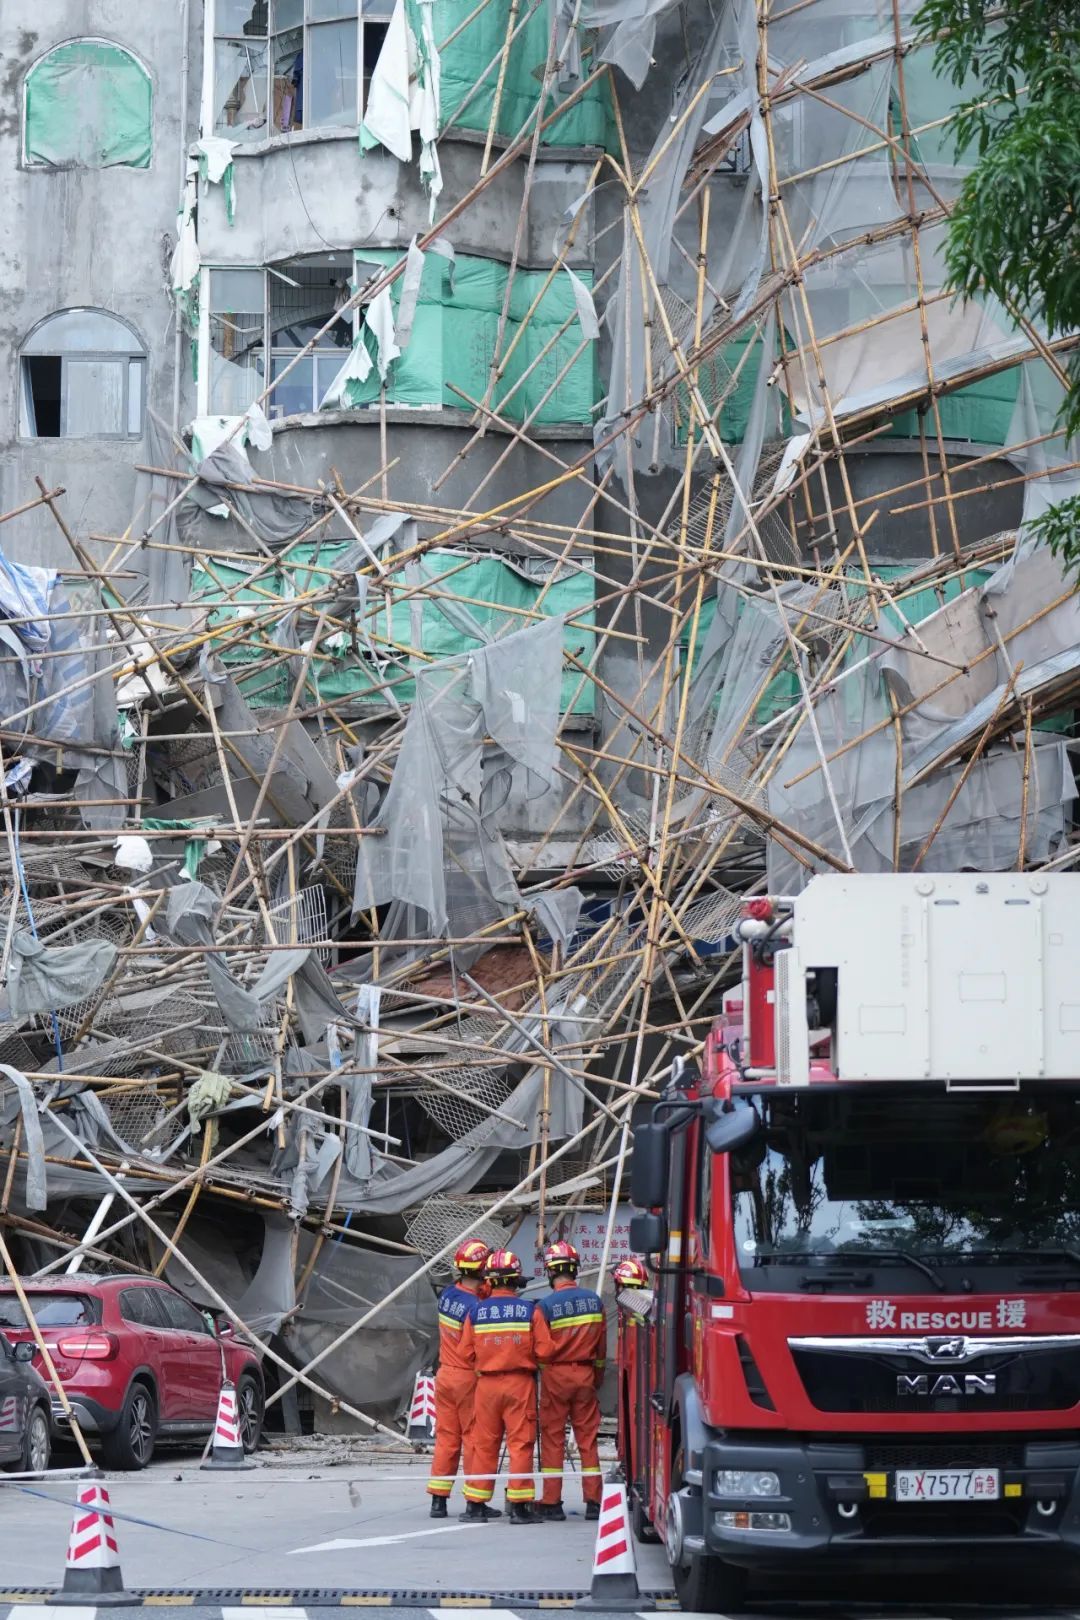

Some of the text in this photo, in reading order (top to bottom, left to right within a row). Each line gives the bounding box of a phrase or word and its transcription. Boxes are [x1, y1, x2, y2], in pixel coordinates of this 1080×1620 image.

[477, 1304, 528, 1321] 应急消防
[552, 1298, 598, 1318] 应急消防
[866, 1299, 1027, 1330] 救 RESCUE 援
[896, 1374, 996, 1396] MAN
